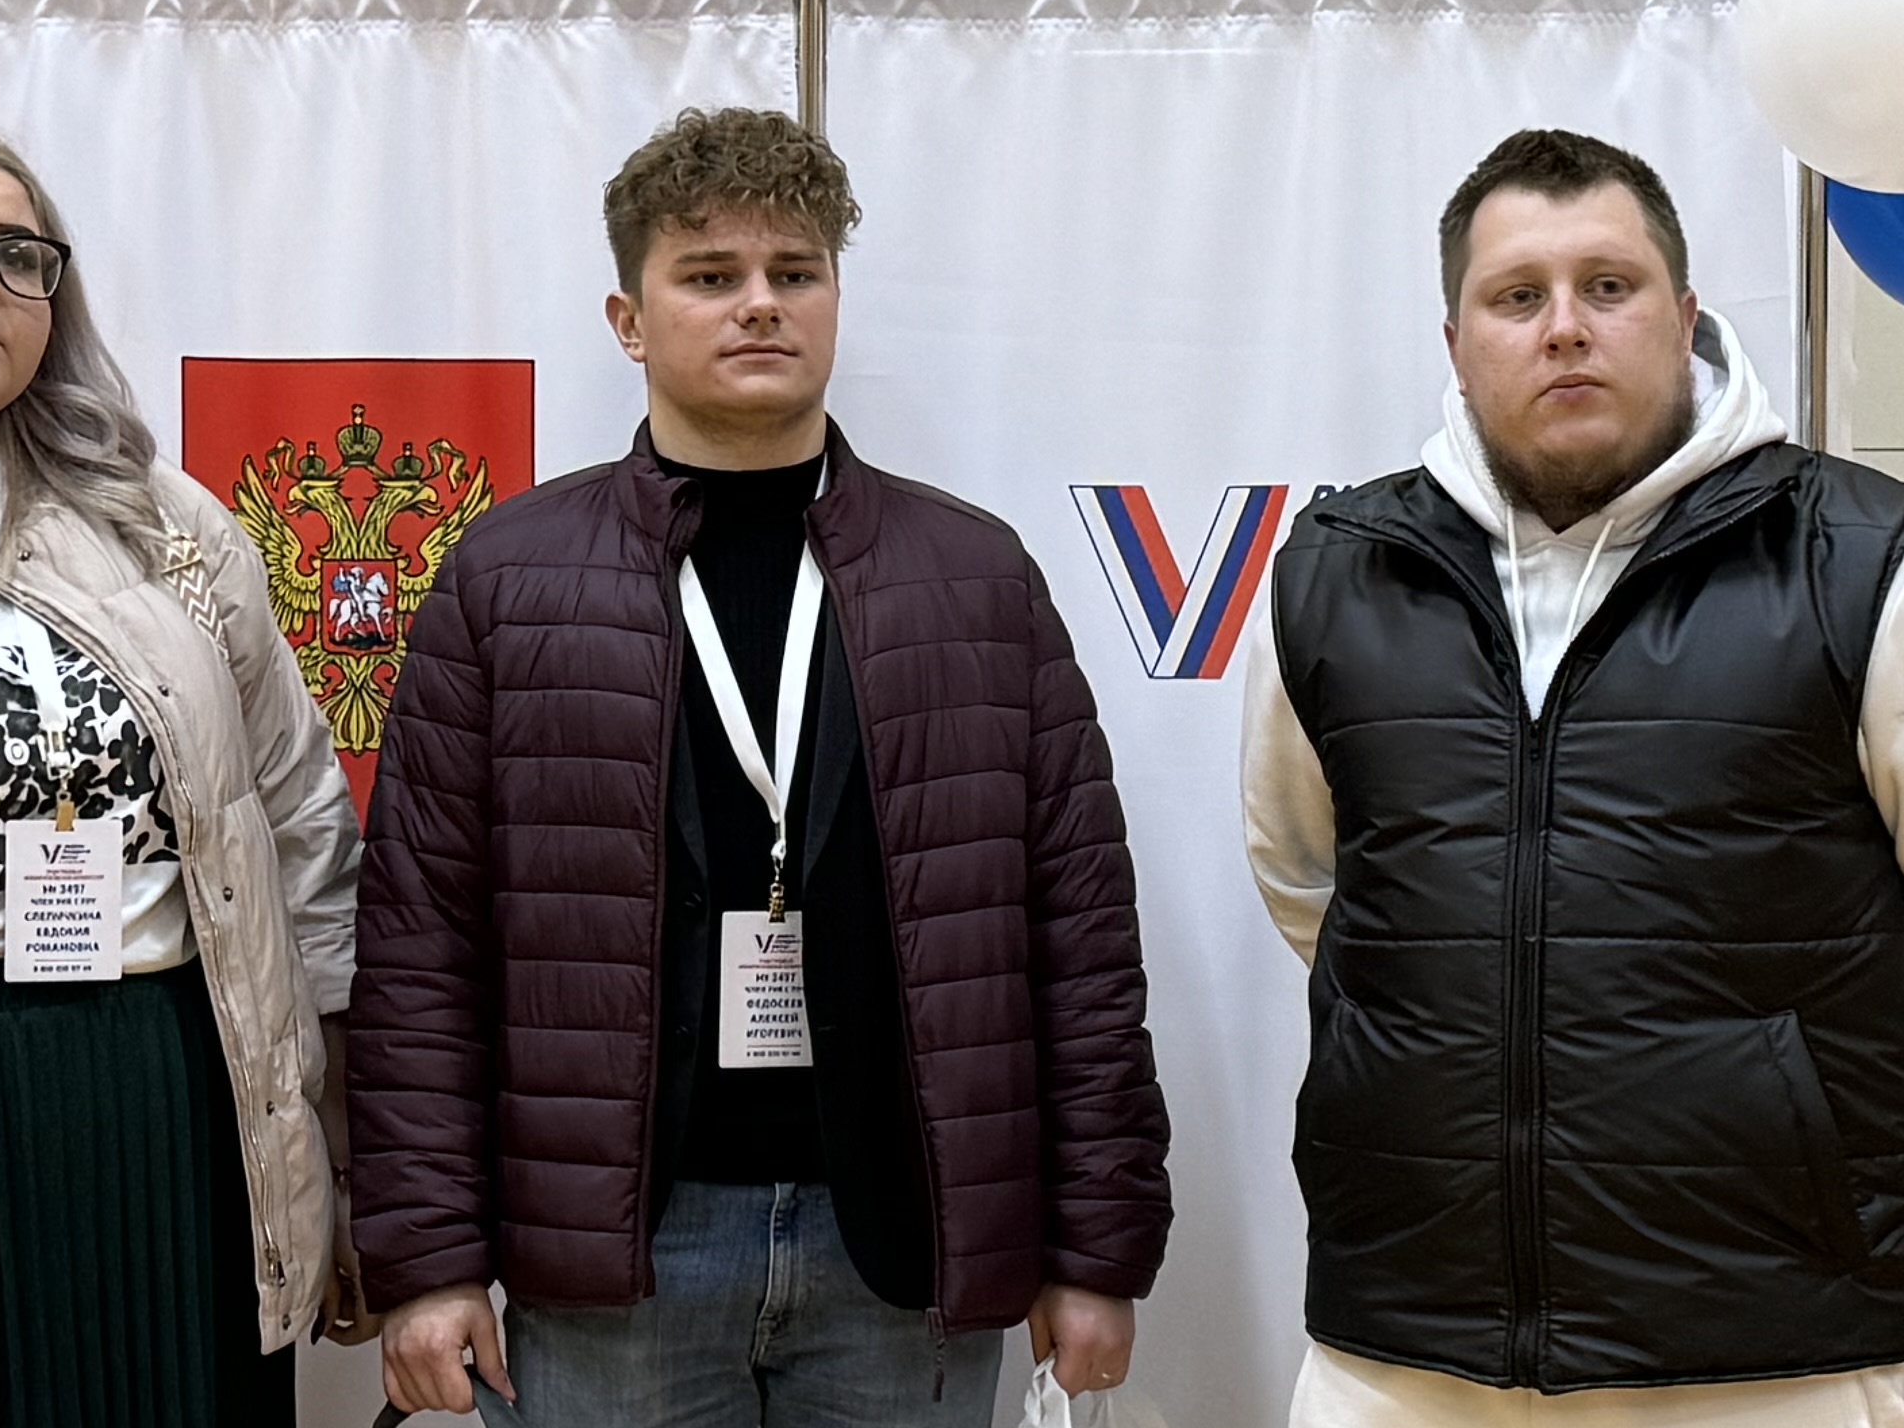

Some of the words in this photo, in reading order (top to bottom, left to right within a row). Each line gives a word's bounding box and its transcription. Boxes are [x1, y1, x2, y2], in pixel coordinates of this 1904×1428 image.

[36, 927, 90, 938] ЕВДОКИЯ
[25, 942, 100, 952] РОМАНОВНА
[746, 998, 803, 1010] ФЕДОСЕЕВ
[750, 1012, 799, 1023] АЛЕКСЕЙ
[746, 1029, 802, 1038] ИГОРЕВИЧ
